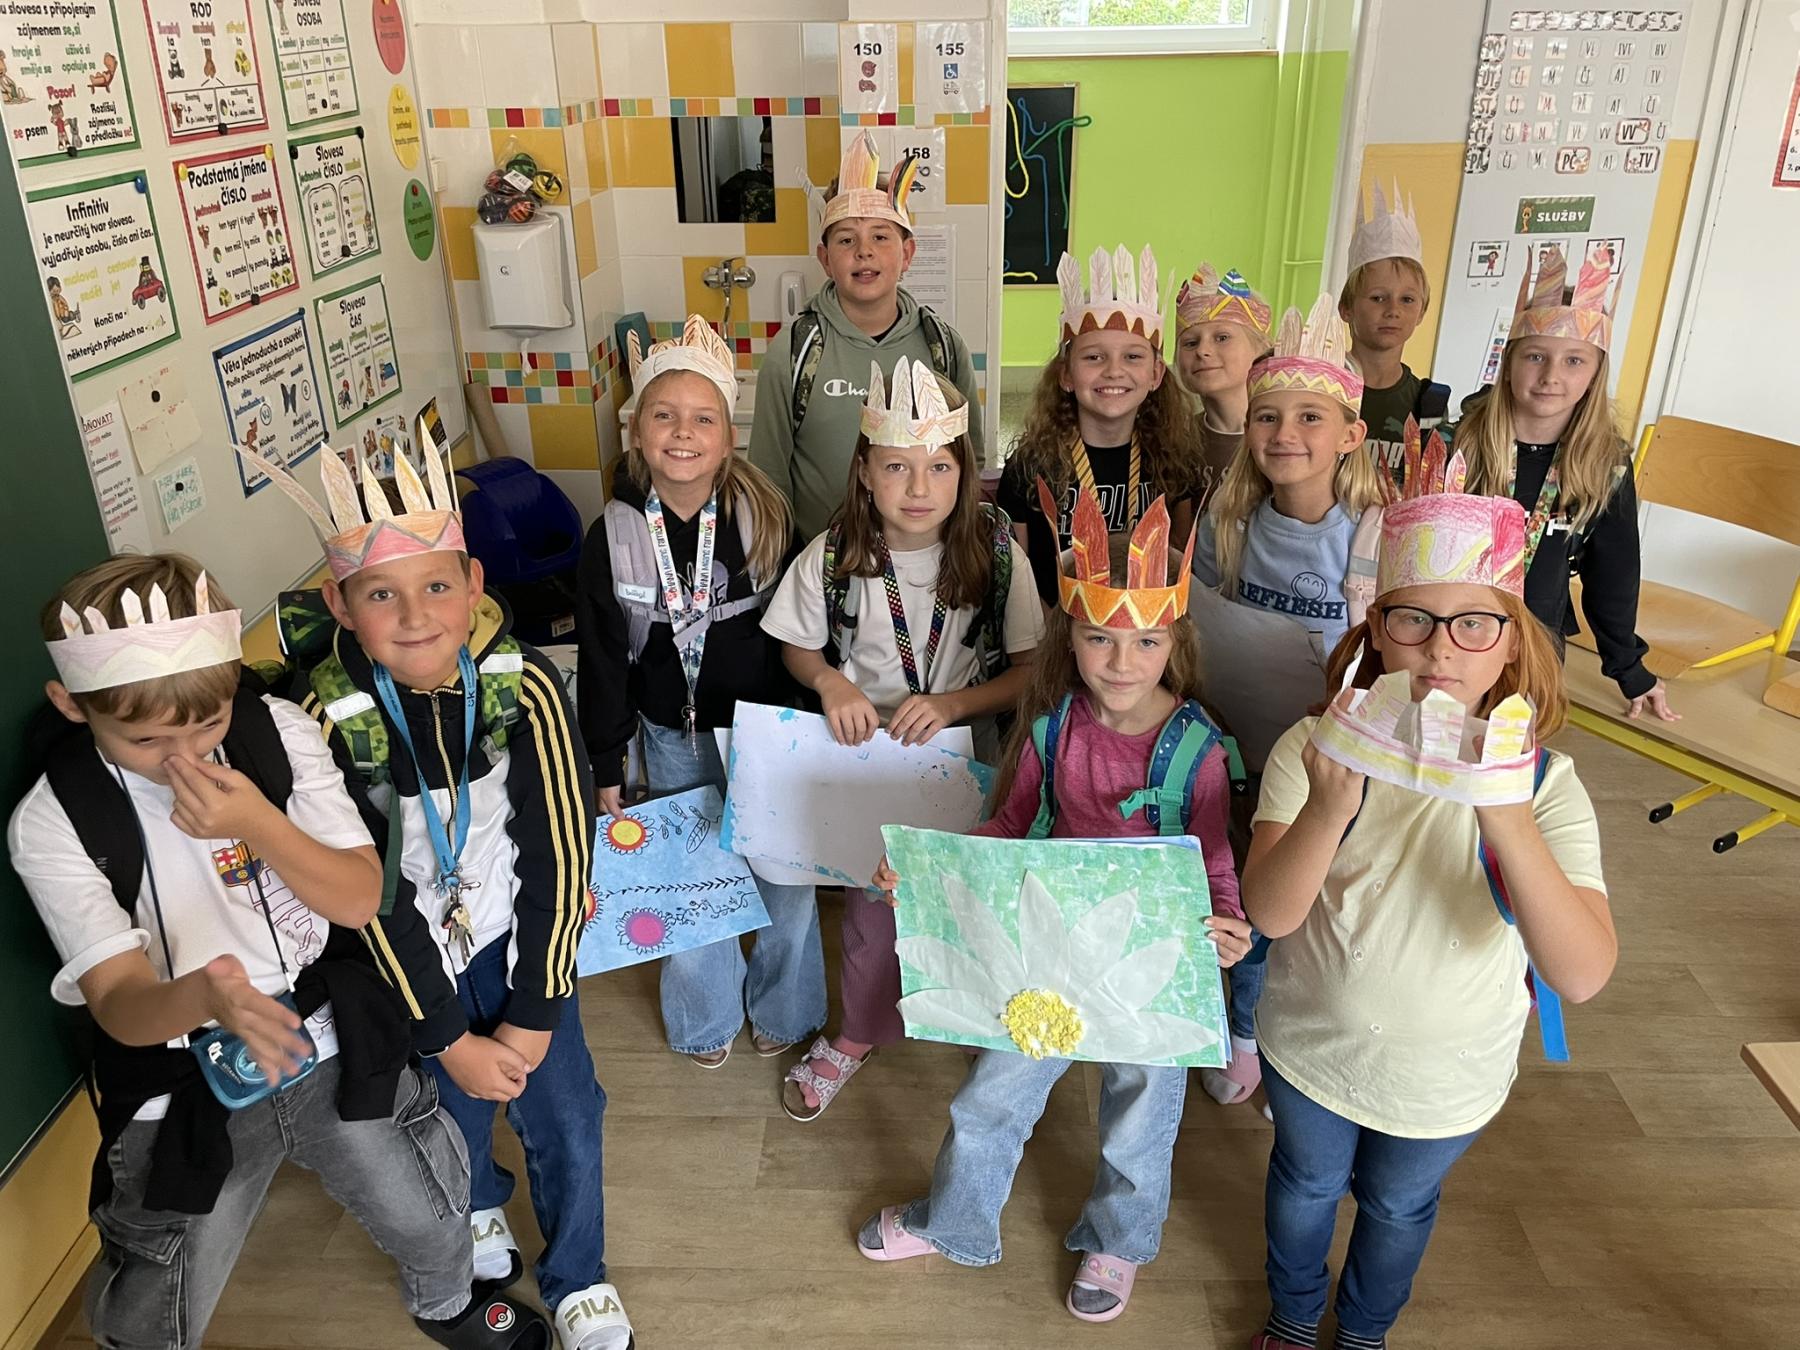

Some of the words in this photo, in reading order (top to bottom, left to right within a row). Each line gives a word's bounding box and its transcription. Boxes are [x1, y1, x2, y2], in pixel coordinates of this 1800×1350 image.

[8, 2, 42, 15] slovesa
[43, 4, 49, 15] s
[50, 1, 96, 19] připojeným
[190, 2, 212, 18] ROD
[296, 12, 323, 26] OSOBA
[1660, 14, 1668, 29] 5.
[17, 23, 61, 40] zájmenem
[853, 43, 882, 56] 150
[935, 43, 964, 56] 155
[1552, 42, 1559, 56] M
[1614, 67, 1625, 84] AJ
[1650, 69, 1661, 84] TV
[46, 83, 77, 99] Pozor!
[1479, 97, 1493, 114] ST
[1509, 95, 1519, 114] ČJ
[1543, 97, 1552, 111] M
[1610, 98, 1621, 114] AJ
[1646, 95, 1656, 114] ČJ
[13, 127, 25, 140] se
[25, 125, 49, 141] psem
[85, 133, 91, 143] a
[1505, 123, 1515, 142] ČJ
[1622, 124, 1638, 140] VV
[1657, 121, 1667, 142] ČJ
[902, 147, 930, 160] 158
[1502, 151, 1512, 169] ČJ
[1562, 148, 1577, 171] PČ
[1639, 152, 1654, 168] TV
[187, 161, 240, 190] Podstatná
[240, 158, 268, 183] jména
[323, 161, 343, 179] ČÍSLO
[220, 185, 247, 207] ČÍSLO
[66, 197, 110, 222] Infinitiv
[1536, 208, 1586, 223] SLUŽBY
[43, 232, 53, 249] je
[54, 222, 91, 245] neurčitý
[90, 222, 107, 235] tvar
[41, 244, 85, 269] vyjadřuje
[85, 240, 112, 256] osobu,
[111, 233, 128, 248] číslo
[128, 231, 140, 242] ani
[139, 227, 154, 239] čas.
[93, 312, 114, 329] Končí
[114, 311, 124, 321] na
[349, 311, 362, 329] ČAS
[66, 339, 103, 363] některých
[103, 330, 136, 351] případech
[136, 326, 145, 336] na
[222, 357, 241, 375] Věta
[240, 338, 279, 371] jednoduchá
[278, 339, 284, 349] a
[283, 326, 303, 347] souvětí
[823, 379, 869, 397] Cha
[1238, 578, 1346, 620] REFRESH
[564, 1295, 622, 1334] FILA
